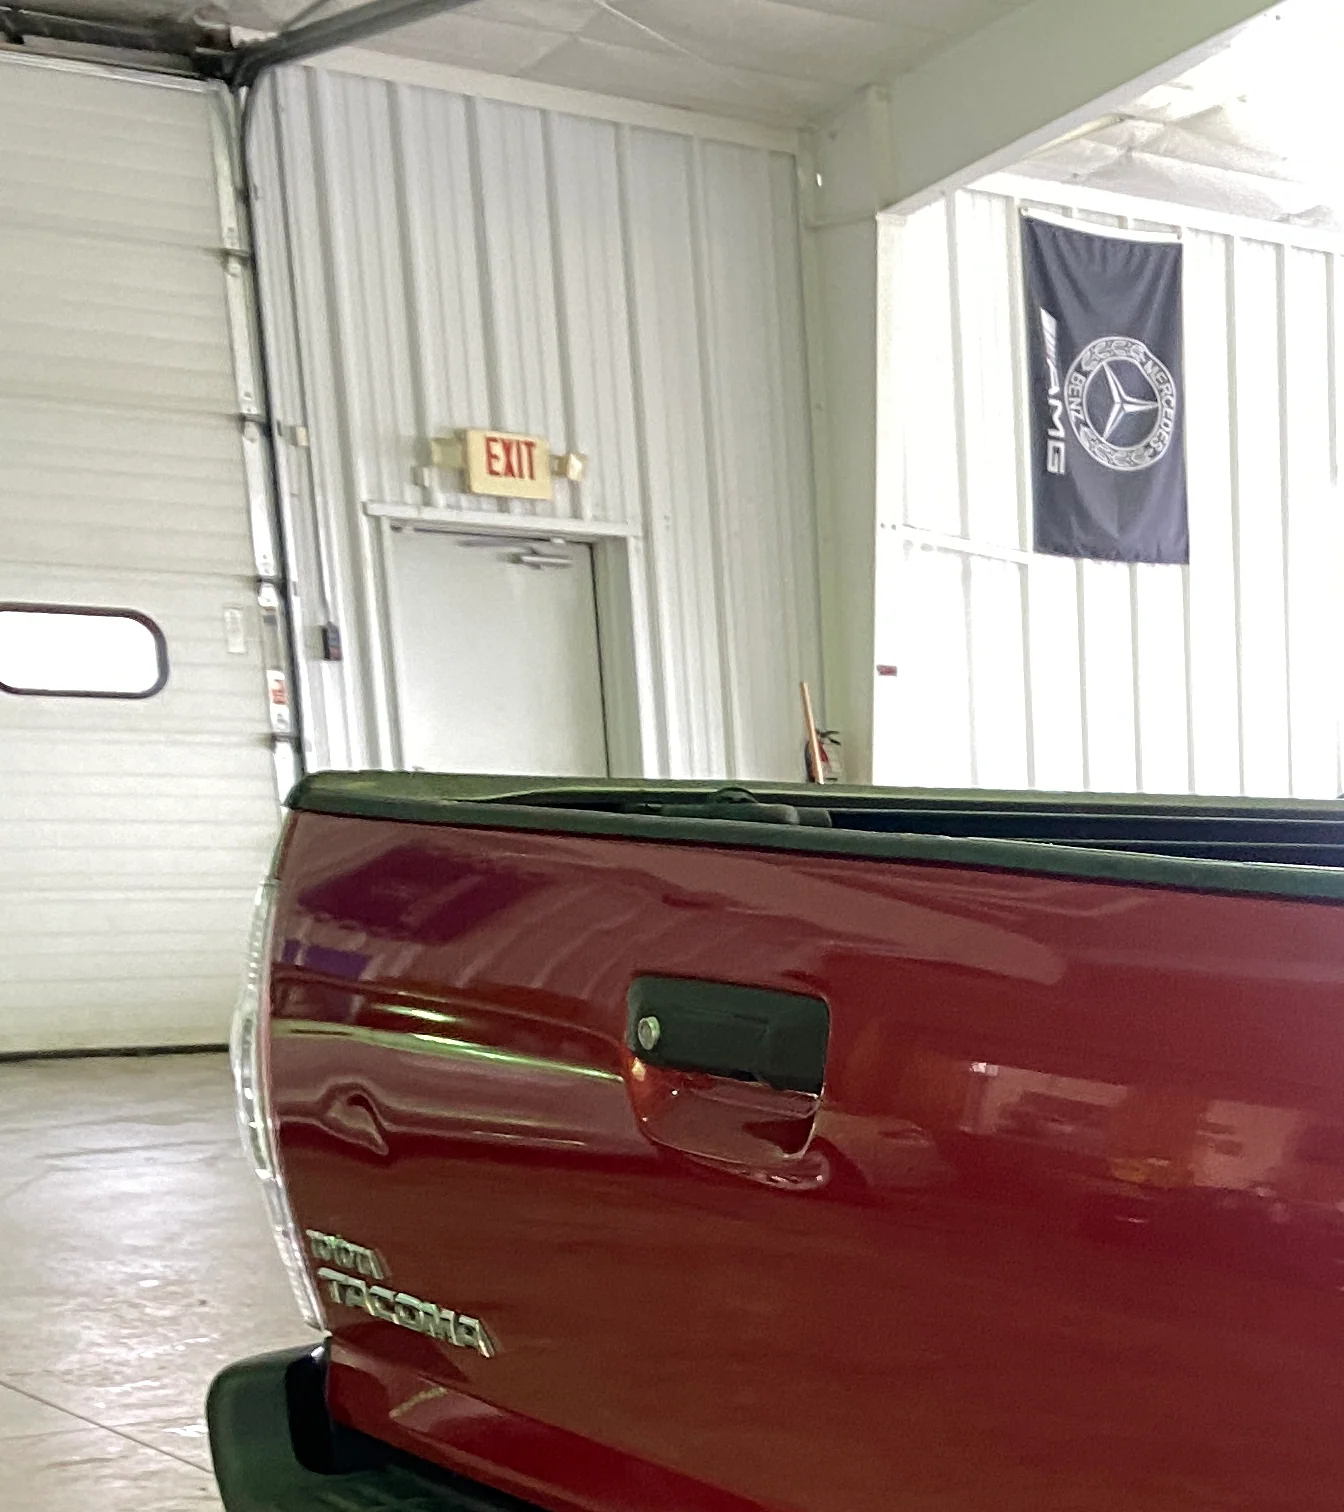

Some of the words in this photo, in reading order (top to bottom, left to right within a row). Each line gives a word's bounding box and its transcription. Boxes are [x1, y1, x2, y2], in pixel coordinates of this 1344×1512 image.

[1046, 357, 1066, 476] AMG
[1067, 370, 1087, 422] BENZ
[1143, 359, 1176, 453] MERCEDES
[484, 436, 537, 481] EXIT
